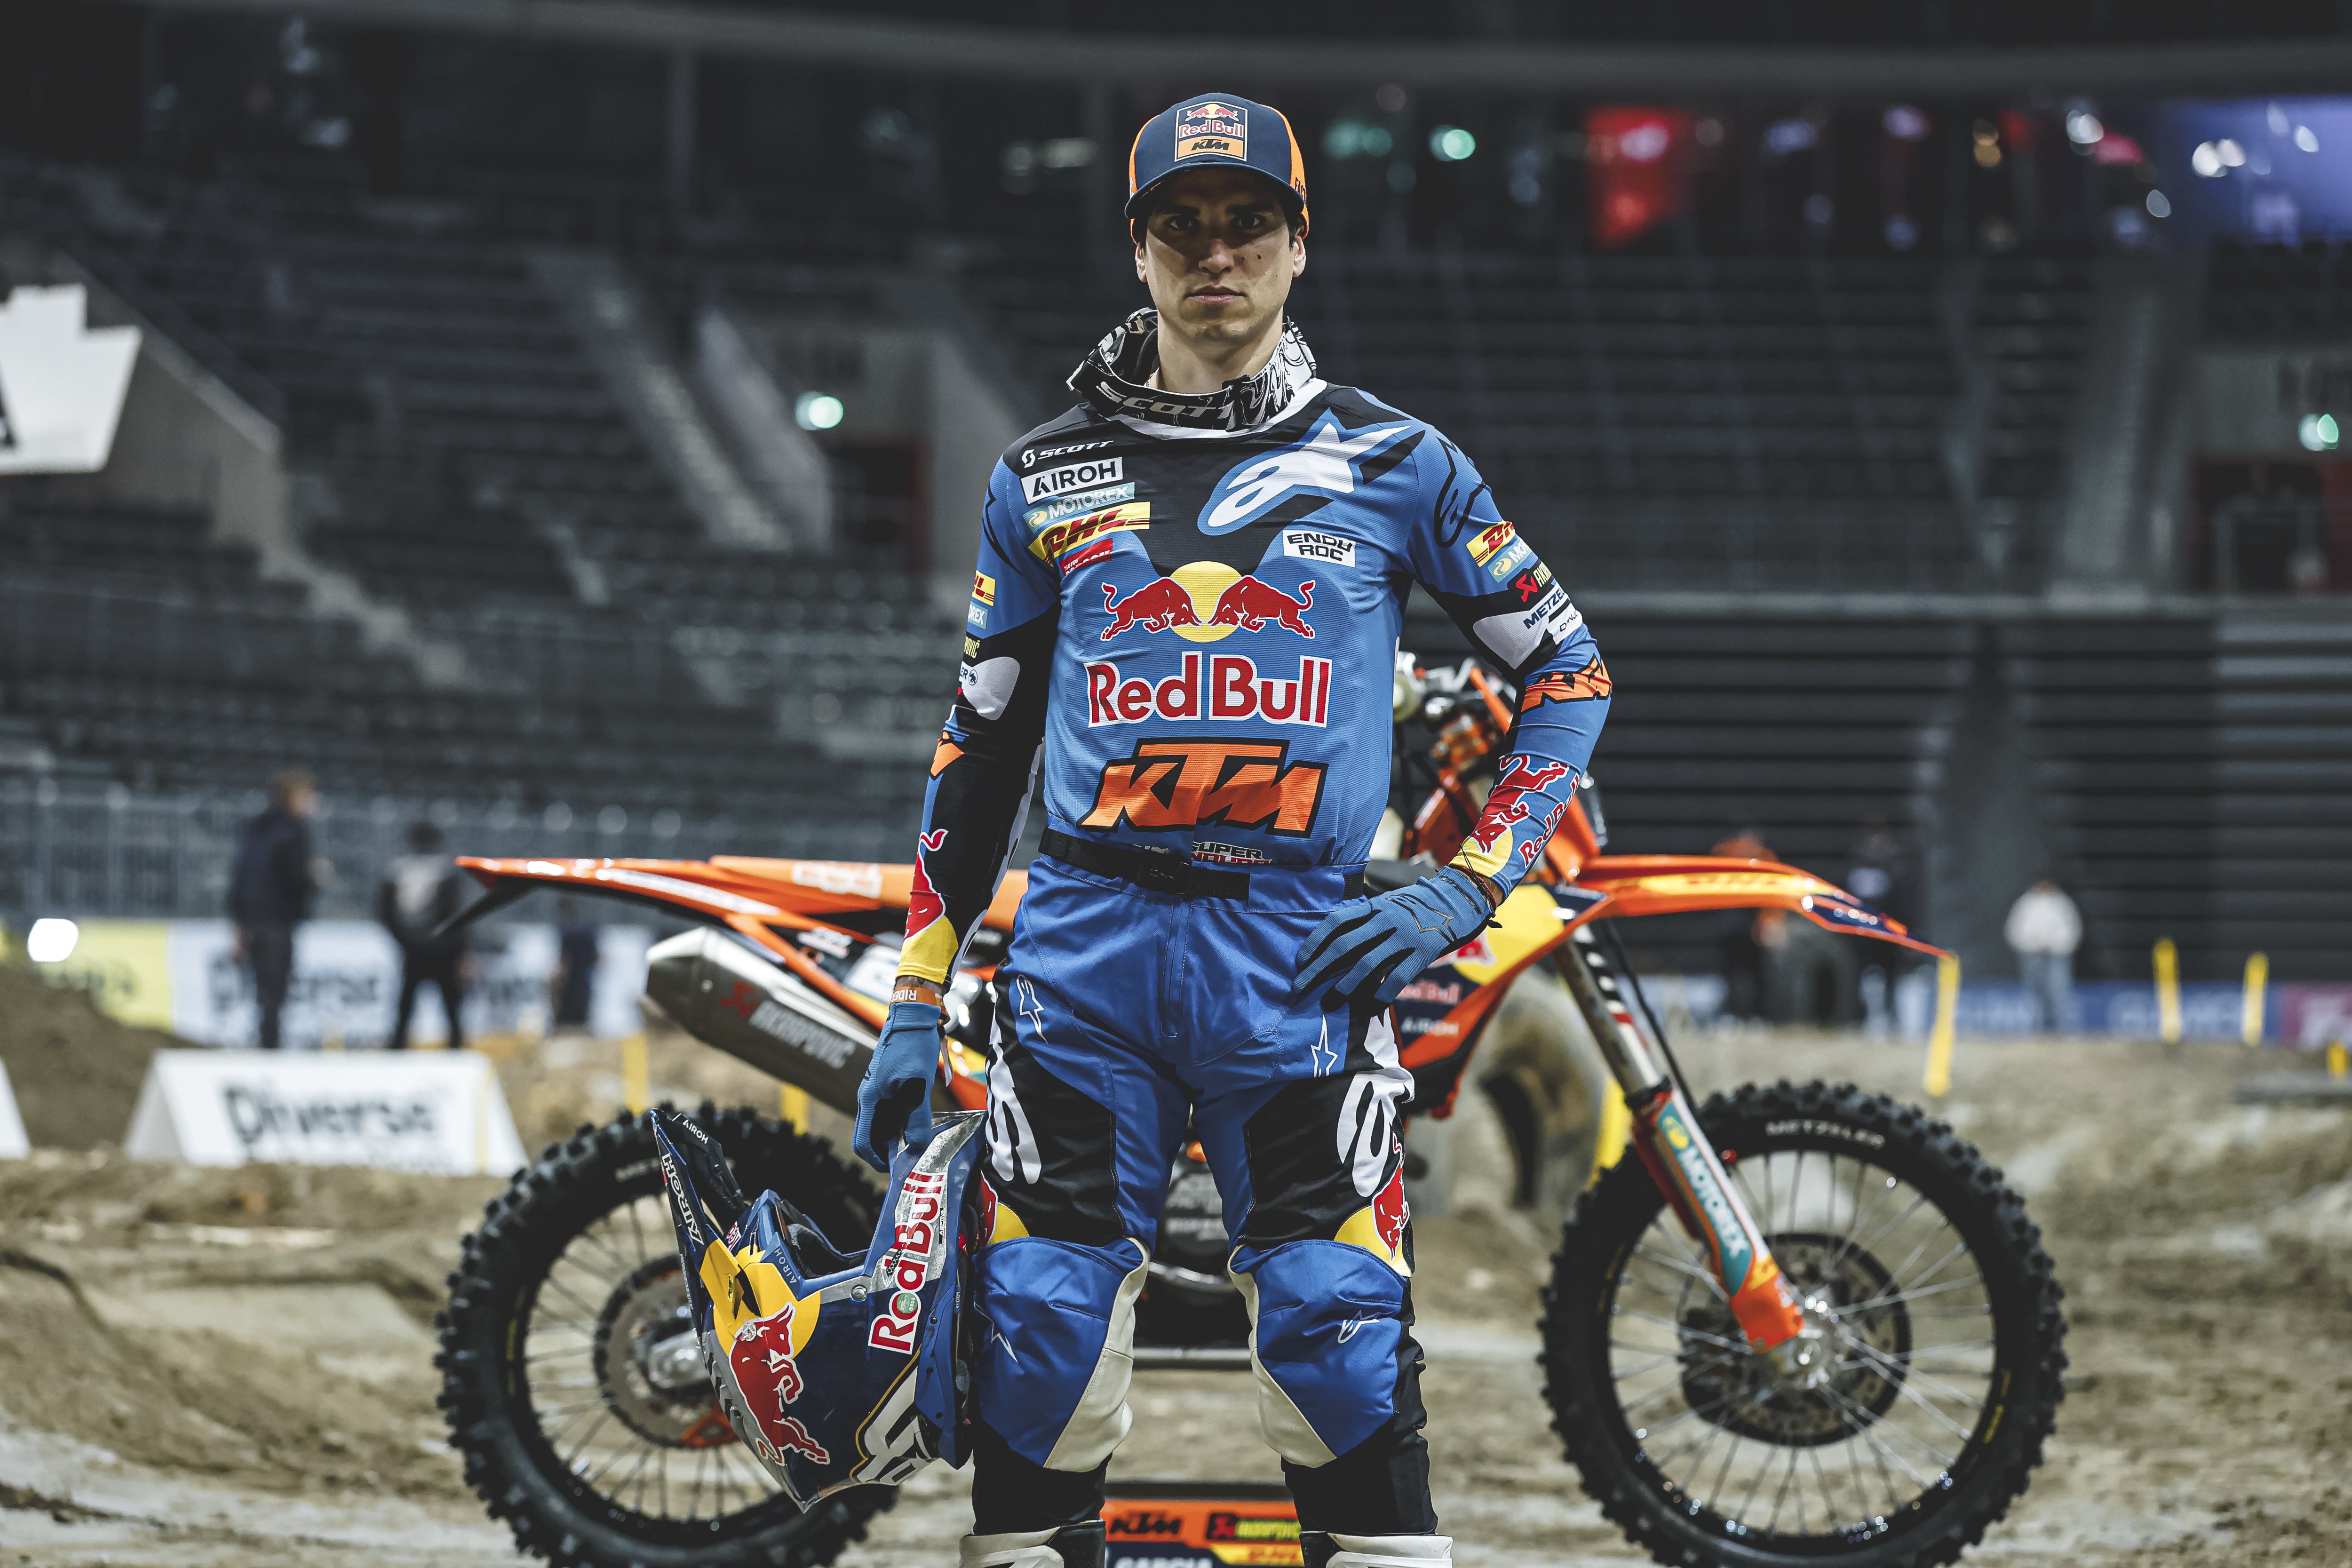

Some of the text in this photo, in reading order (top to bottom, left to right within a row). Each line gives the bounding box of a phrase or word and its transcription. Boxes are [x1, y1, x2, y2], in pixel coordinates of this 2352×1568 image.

[1179, 119, 1244, 138] Red Bull
[1192, 139, 1230, 151] KTM
[1038, 440, 1114, 460] SCOTT
[1033, 461, 1116, 497] AIROH
[1049, 486, 1128, 519] MOTOREX
[1041, 509, 1127, 553] DHL
[1064, 558, 1079, 571] MOTOS
[1084, 651, 1332, 728] Red Bull
[1077, 737, 1329, 838] KTM
[1518, 814, 1552, 869] Red
[683, 1119, 709, 1144] AIROH
[661, 1153, 705, 1246] AIROH
[895, 1171, 945, 1257] Bull
[774, 1248, 797, 1283] AIROH
